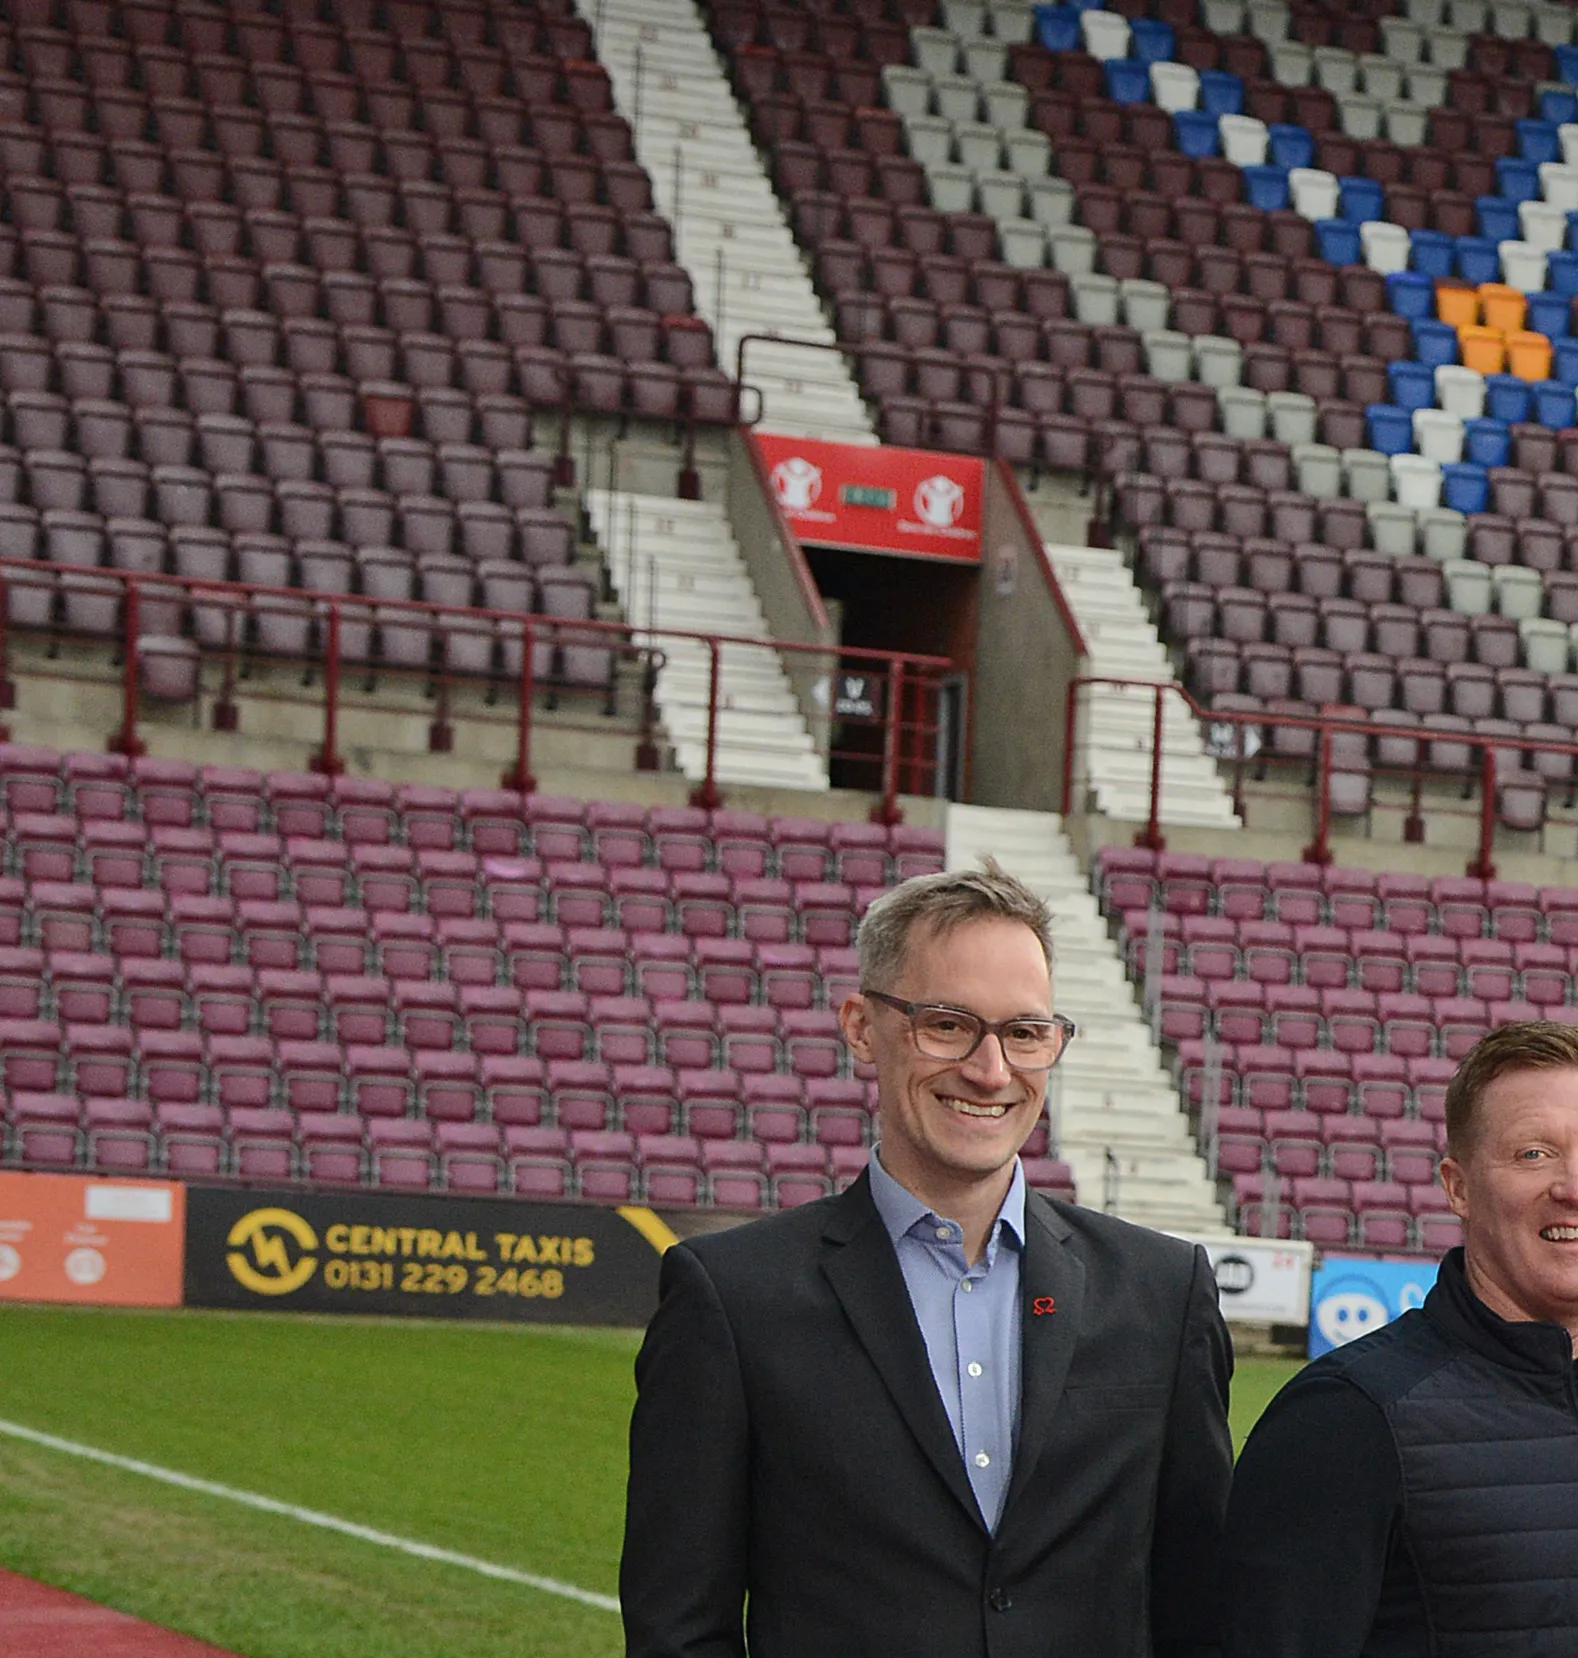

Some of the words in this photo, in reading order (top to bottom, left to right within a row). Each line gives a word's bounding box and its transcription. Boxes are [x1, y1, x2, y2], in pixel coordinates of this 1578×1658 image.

[325, 1223, 486, 1261] CENTRAL
[494, 1232, 594, 1267] TAXIS
[324, 1260, 394, 1291] 0131
[400, 1262, 469, 1294] 229
[474, 1265, 565, 1299] 2468
